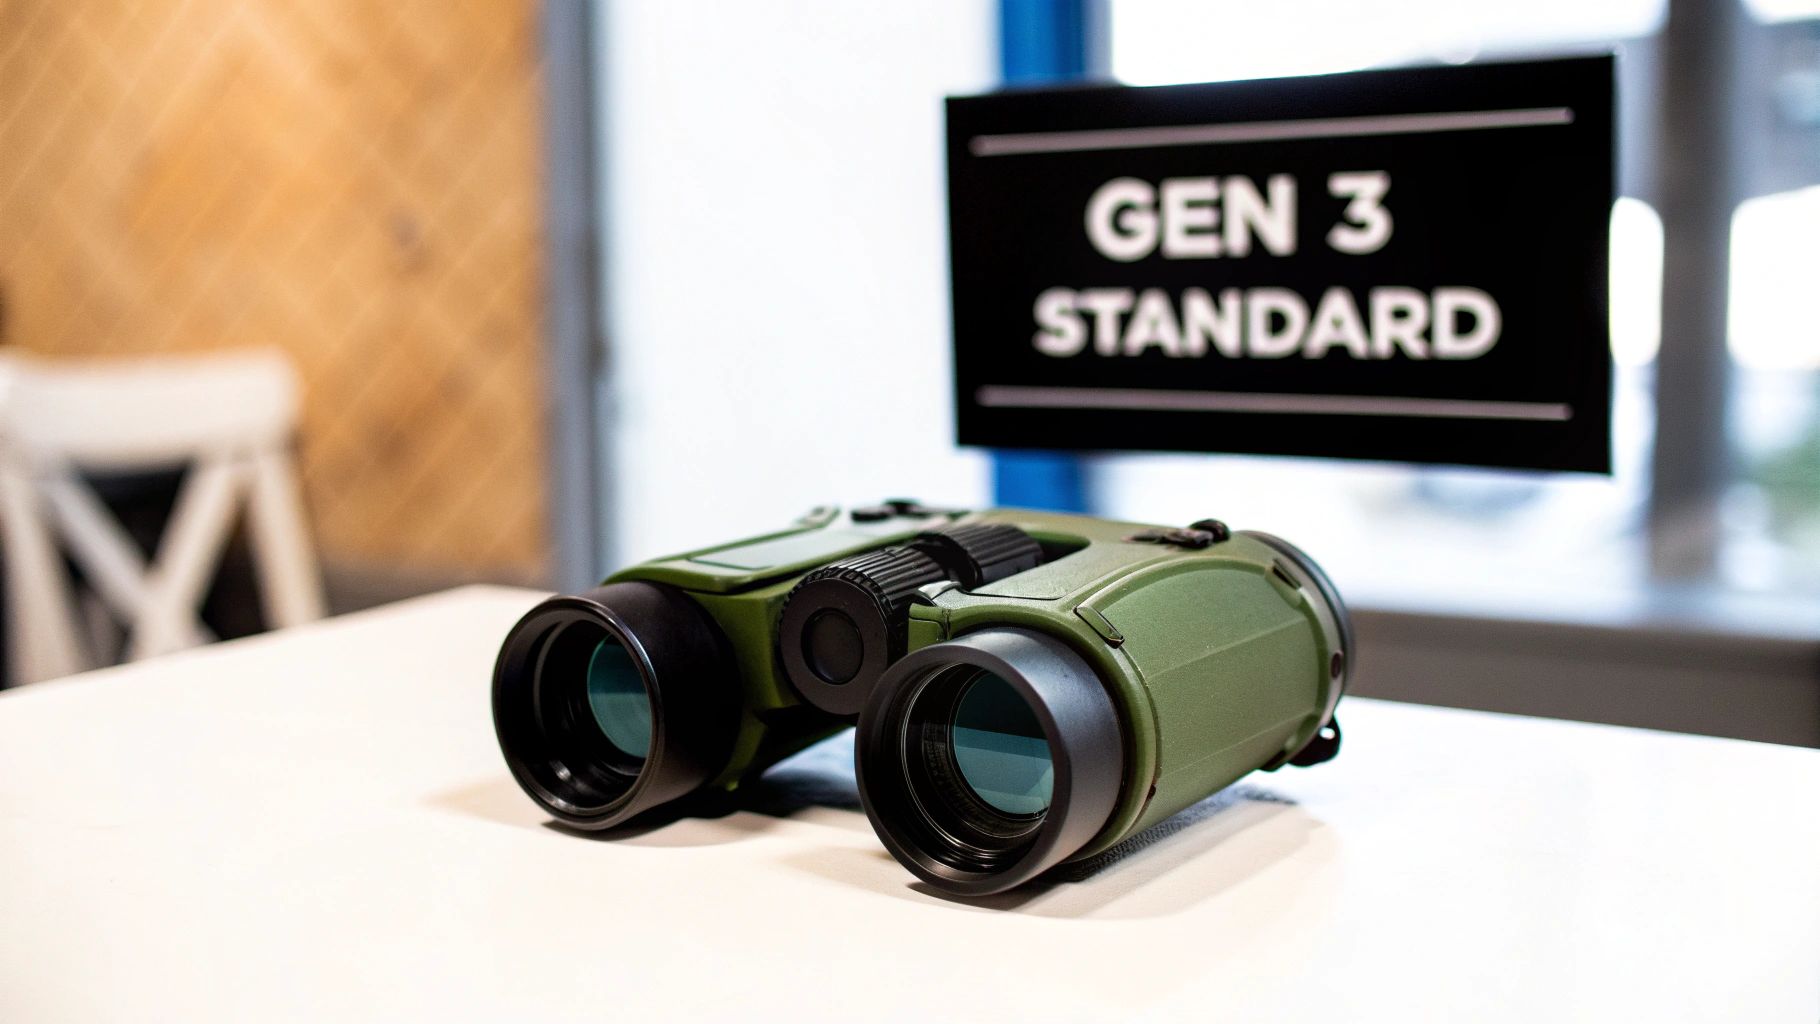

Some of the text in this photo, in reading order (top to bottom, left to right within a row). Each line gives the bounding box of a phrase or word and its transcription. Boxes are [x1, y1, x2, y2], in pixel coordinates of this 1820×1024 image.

[1086, 171, 1393, 262] GEN 3
[1033, 287, 1501, 359] STANDARD
